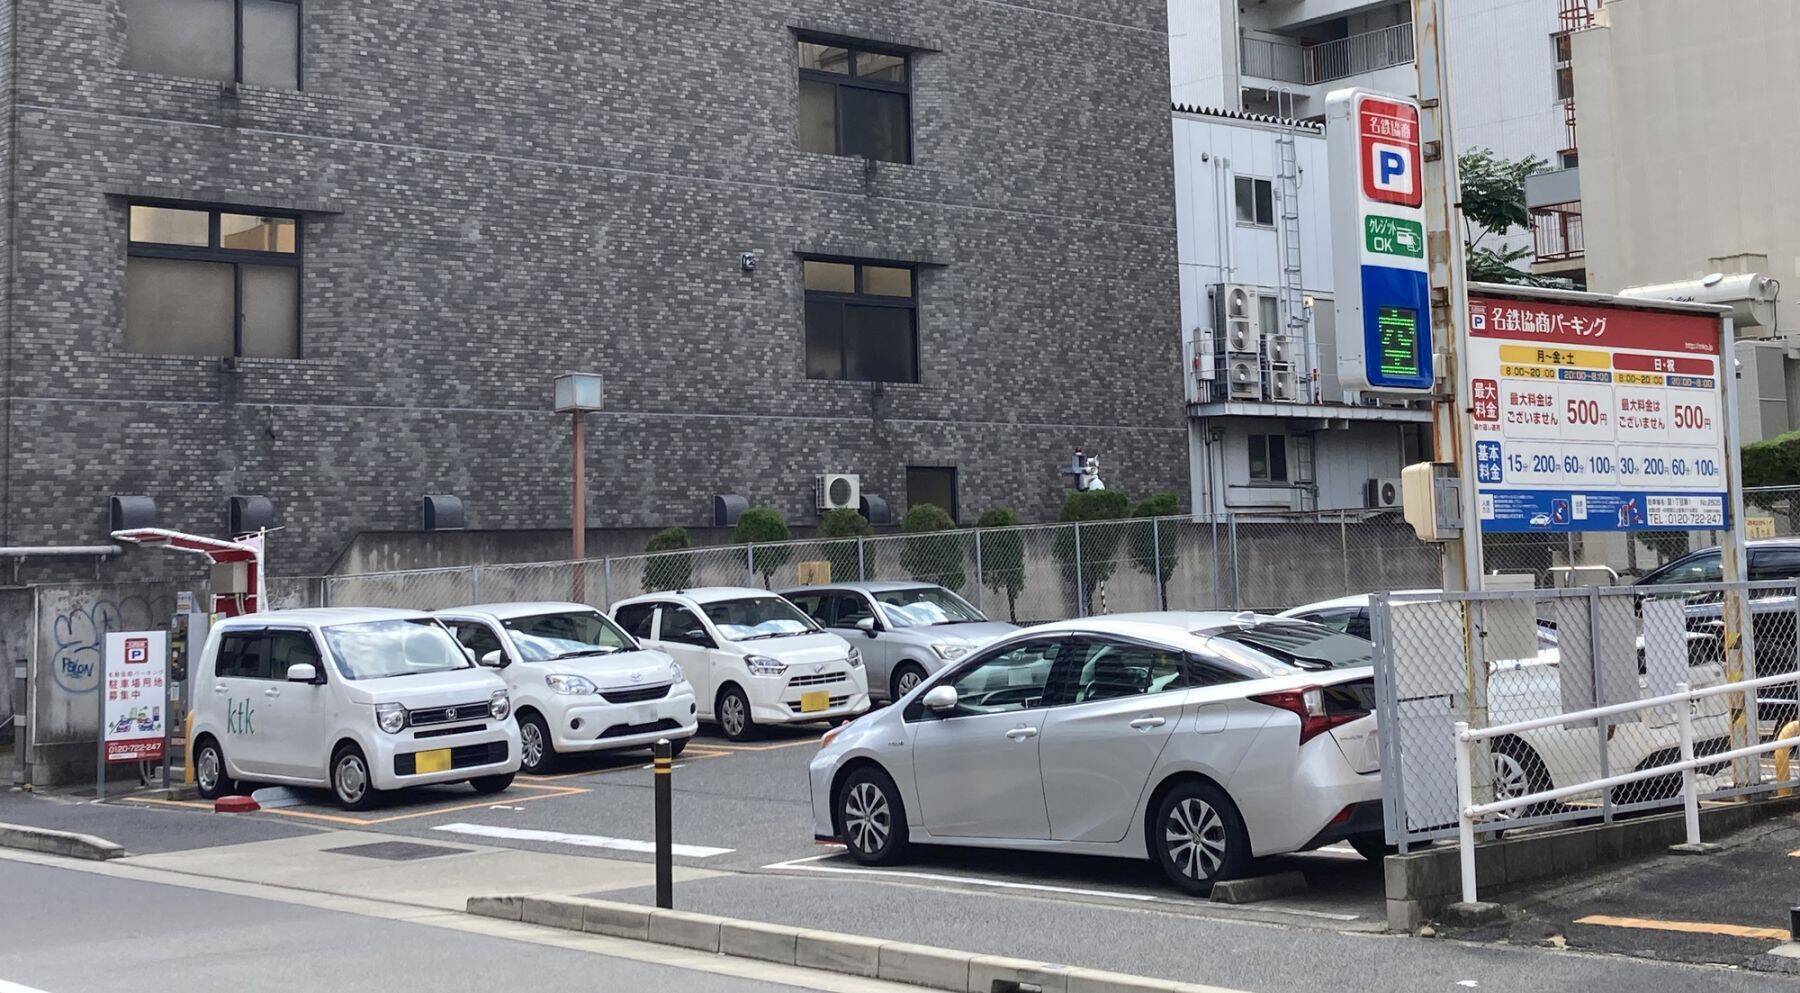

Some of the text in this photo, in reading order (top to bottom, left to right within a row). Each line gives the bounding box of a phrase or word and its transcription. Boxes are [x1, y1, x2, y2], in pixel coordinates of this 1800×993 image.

[1369, 117, 1411, 139] 名鉄協商
[1380, 150, 1405, 185] P
[1369, 218, 1396, 236] クレジット
[1374, 237, 1393, 252] OK
[1474, 317, 1483, 327] P
[1491, 306, 1607, 337] 名鉄協商パーキング
[1474, 382, 1496, 399] 最大
[1510, 393, 1553, 407] 最大料金は
[1621, 399, 1660, 412] 最大料金は
[1475, 402, 1497, 418] 料金
[1507, 411, 1558, 426] ございません
[1567, 400, 1607, 426] 500円
[1675, 405, 1711, 430] 500円
[1619, 416, 1665, 430] ございません
[1478, 444, 1499, 461] 基本
[1479, 463, 1501, 481] 料金
[132, 650, 141, 659] P
[227, 698, 255, 736] ktk
[108, 743, 162, 753] 0120-722-247
